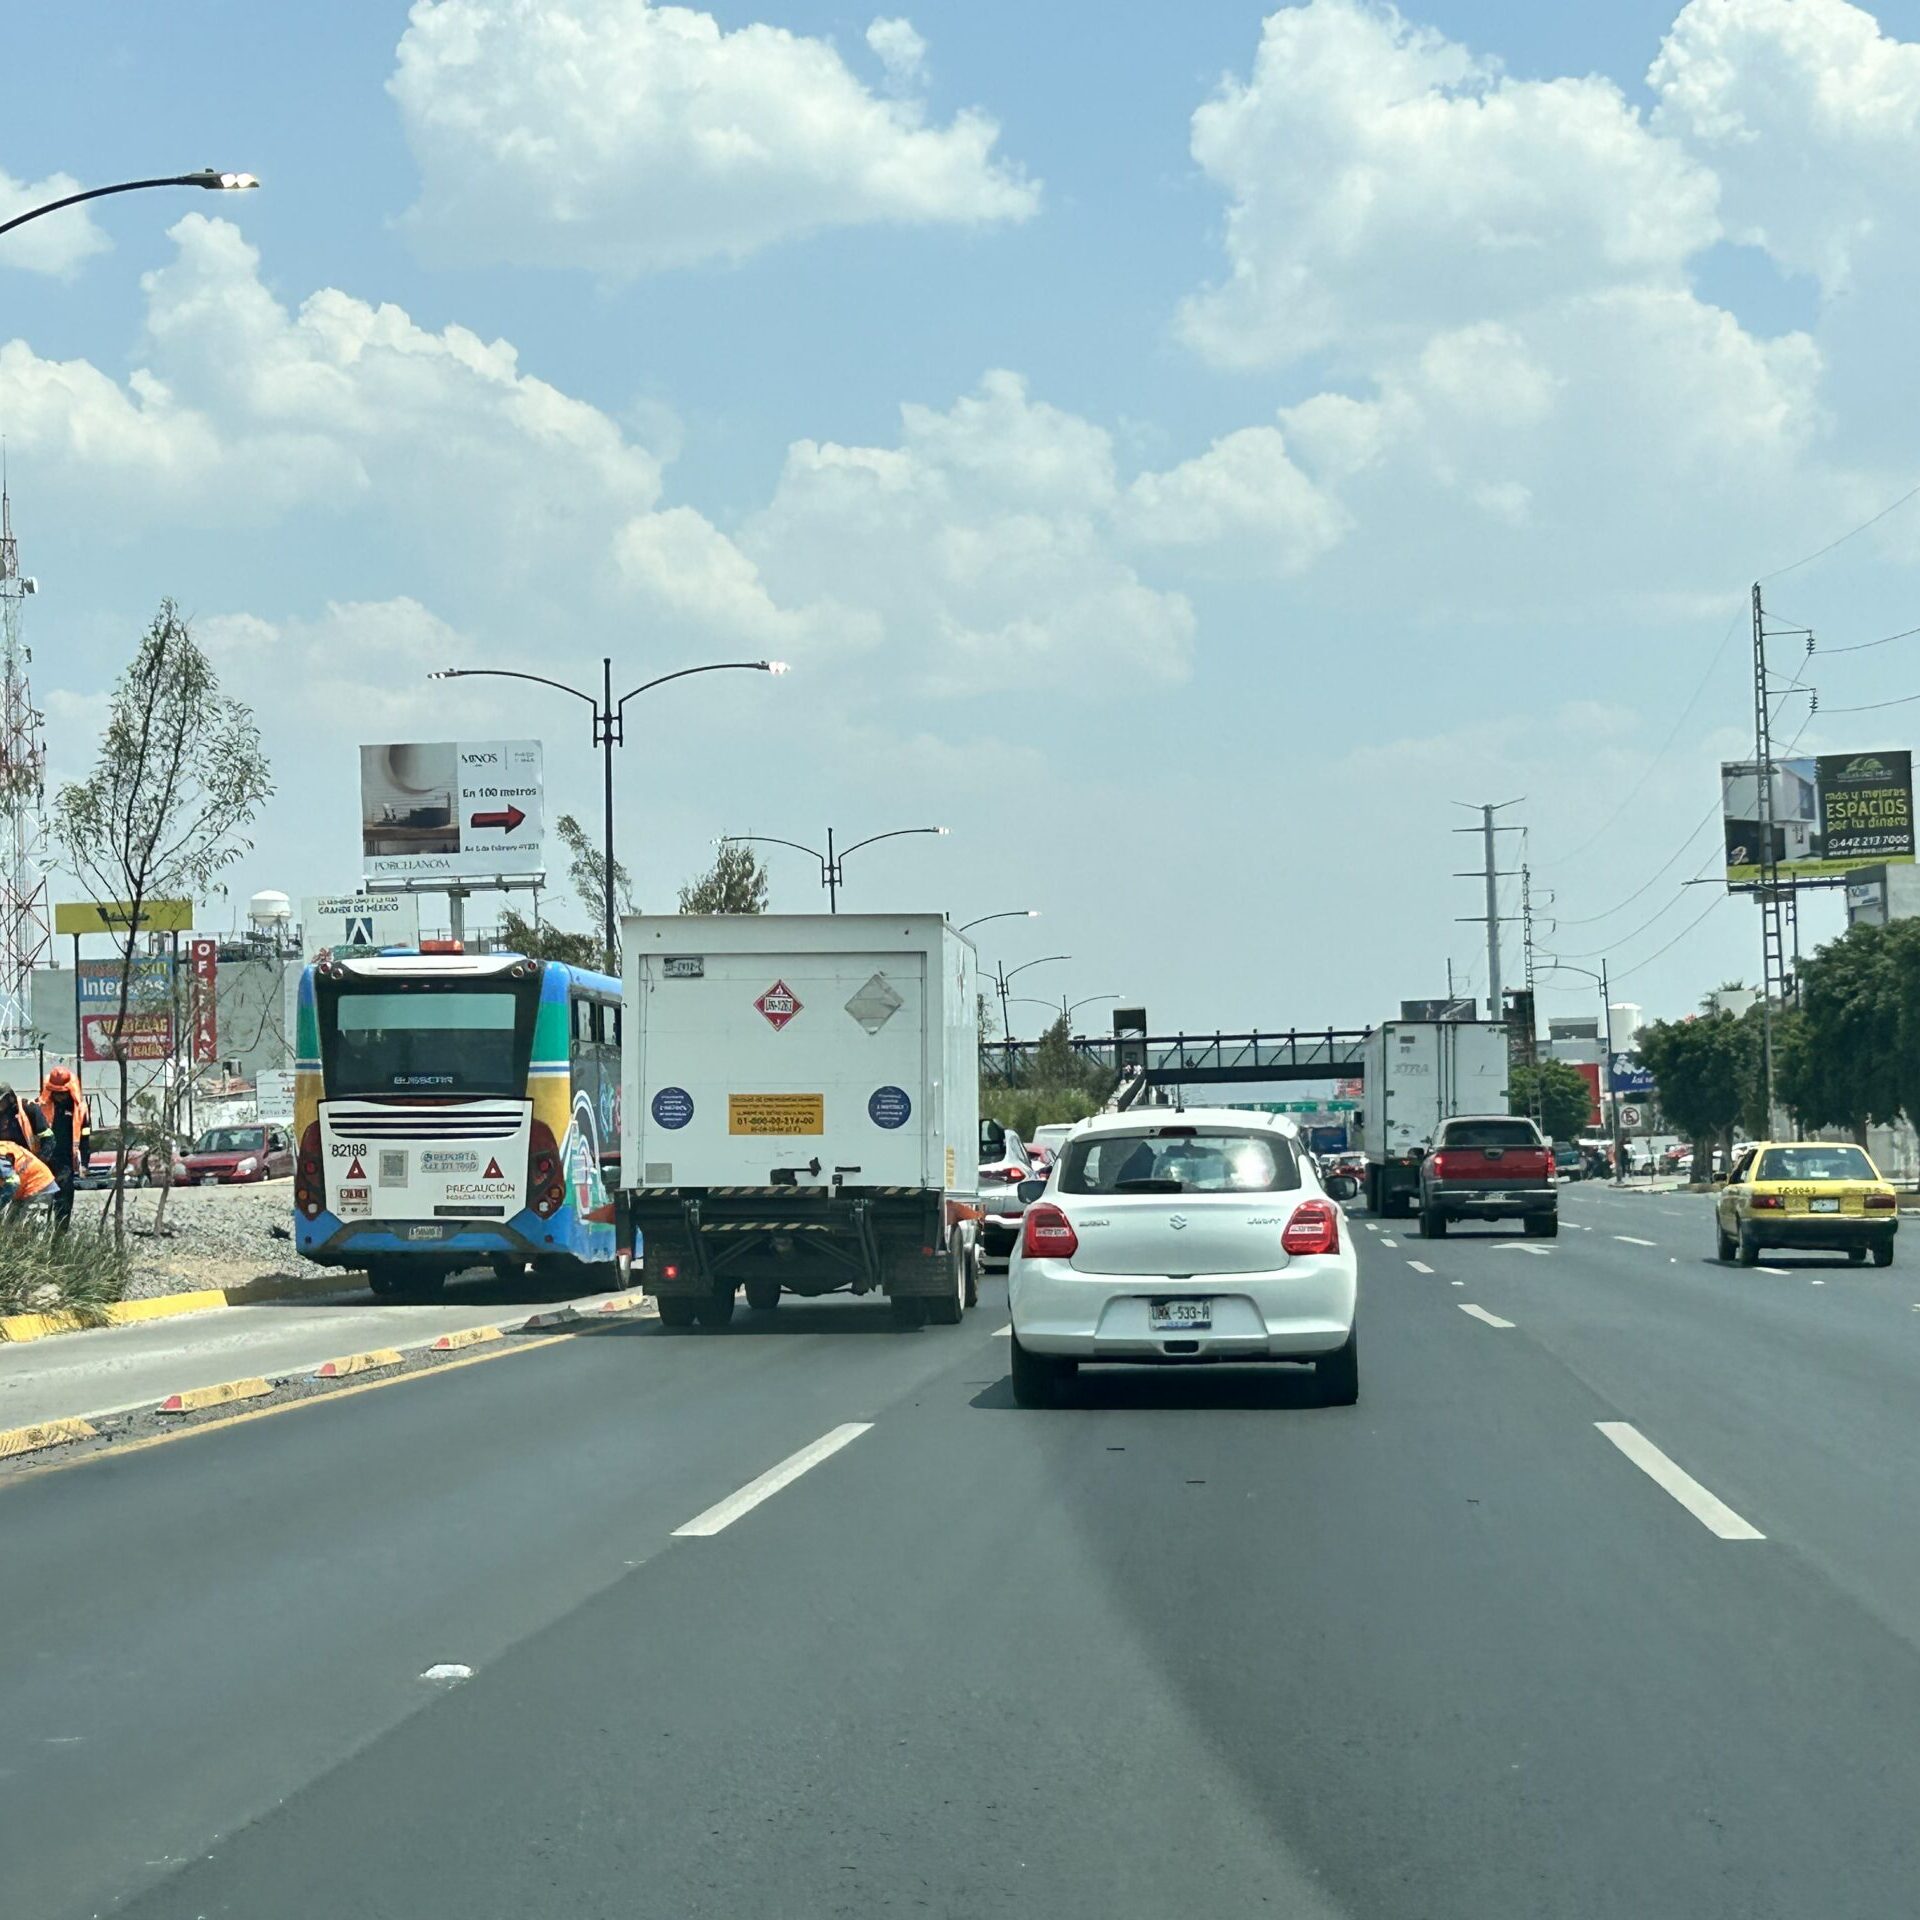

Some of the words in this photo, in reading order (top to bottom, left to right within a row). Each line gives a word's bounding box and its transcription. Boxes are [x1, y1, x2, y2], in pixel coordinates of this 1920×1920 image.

[462, 789, 476, 798] En
[478, 787, 498, 797] 100
[499, 787, 537, 797] metros
[1825, 791, 1849, 800] más
[1851, 790, 1859, 801] y
[1826, 798, 1907, 819] ESPACIOS
[1827, 819, 1848, 834] por
[1852, 818, 1865, 829] tu
[1868, 815, 1908, 828] dinero
[366, 903, 399, 913] MÉXICO
[331, 1143, 367, 1157] 82188
[446, 1182, 516, 1194] PRECAUCIÓN
